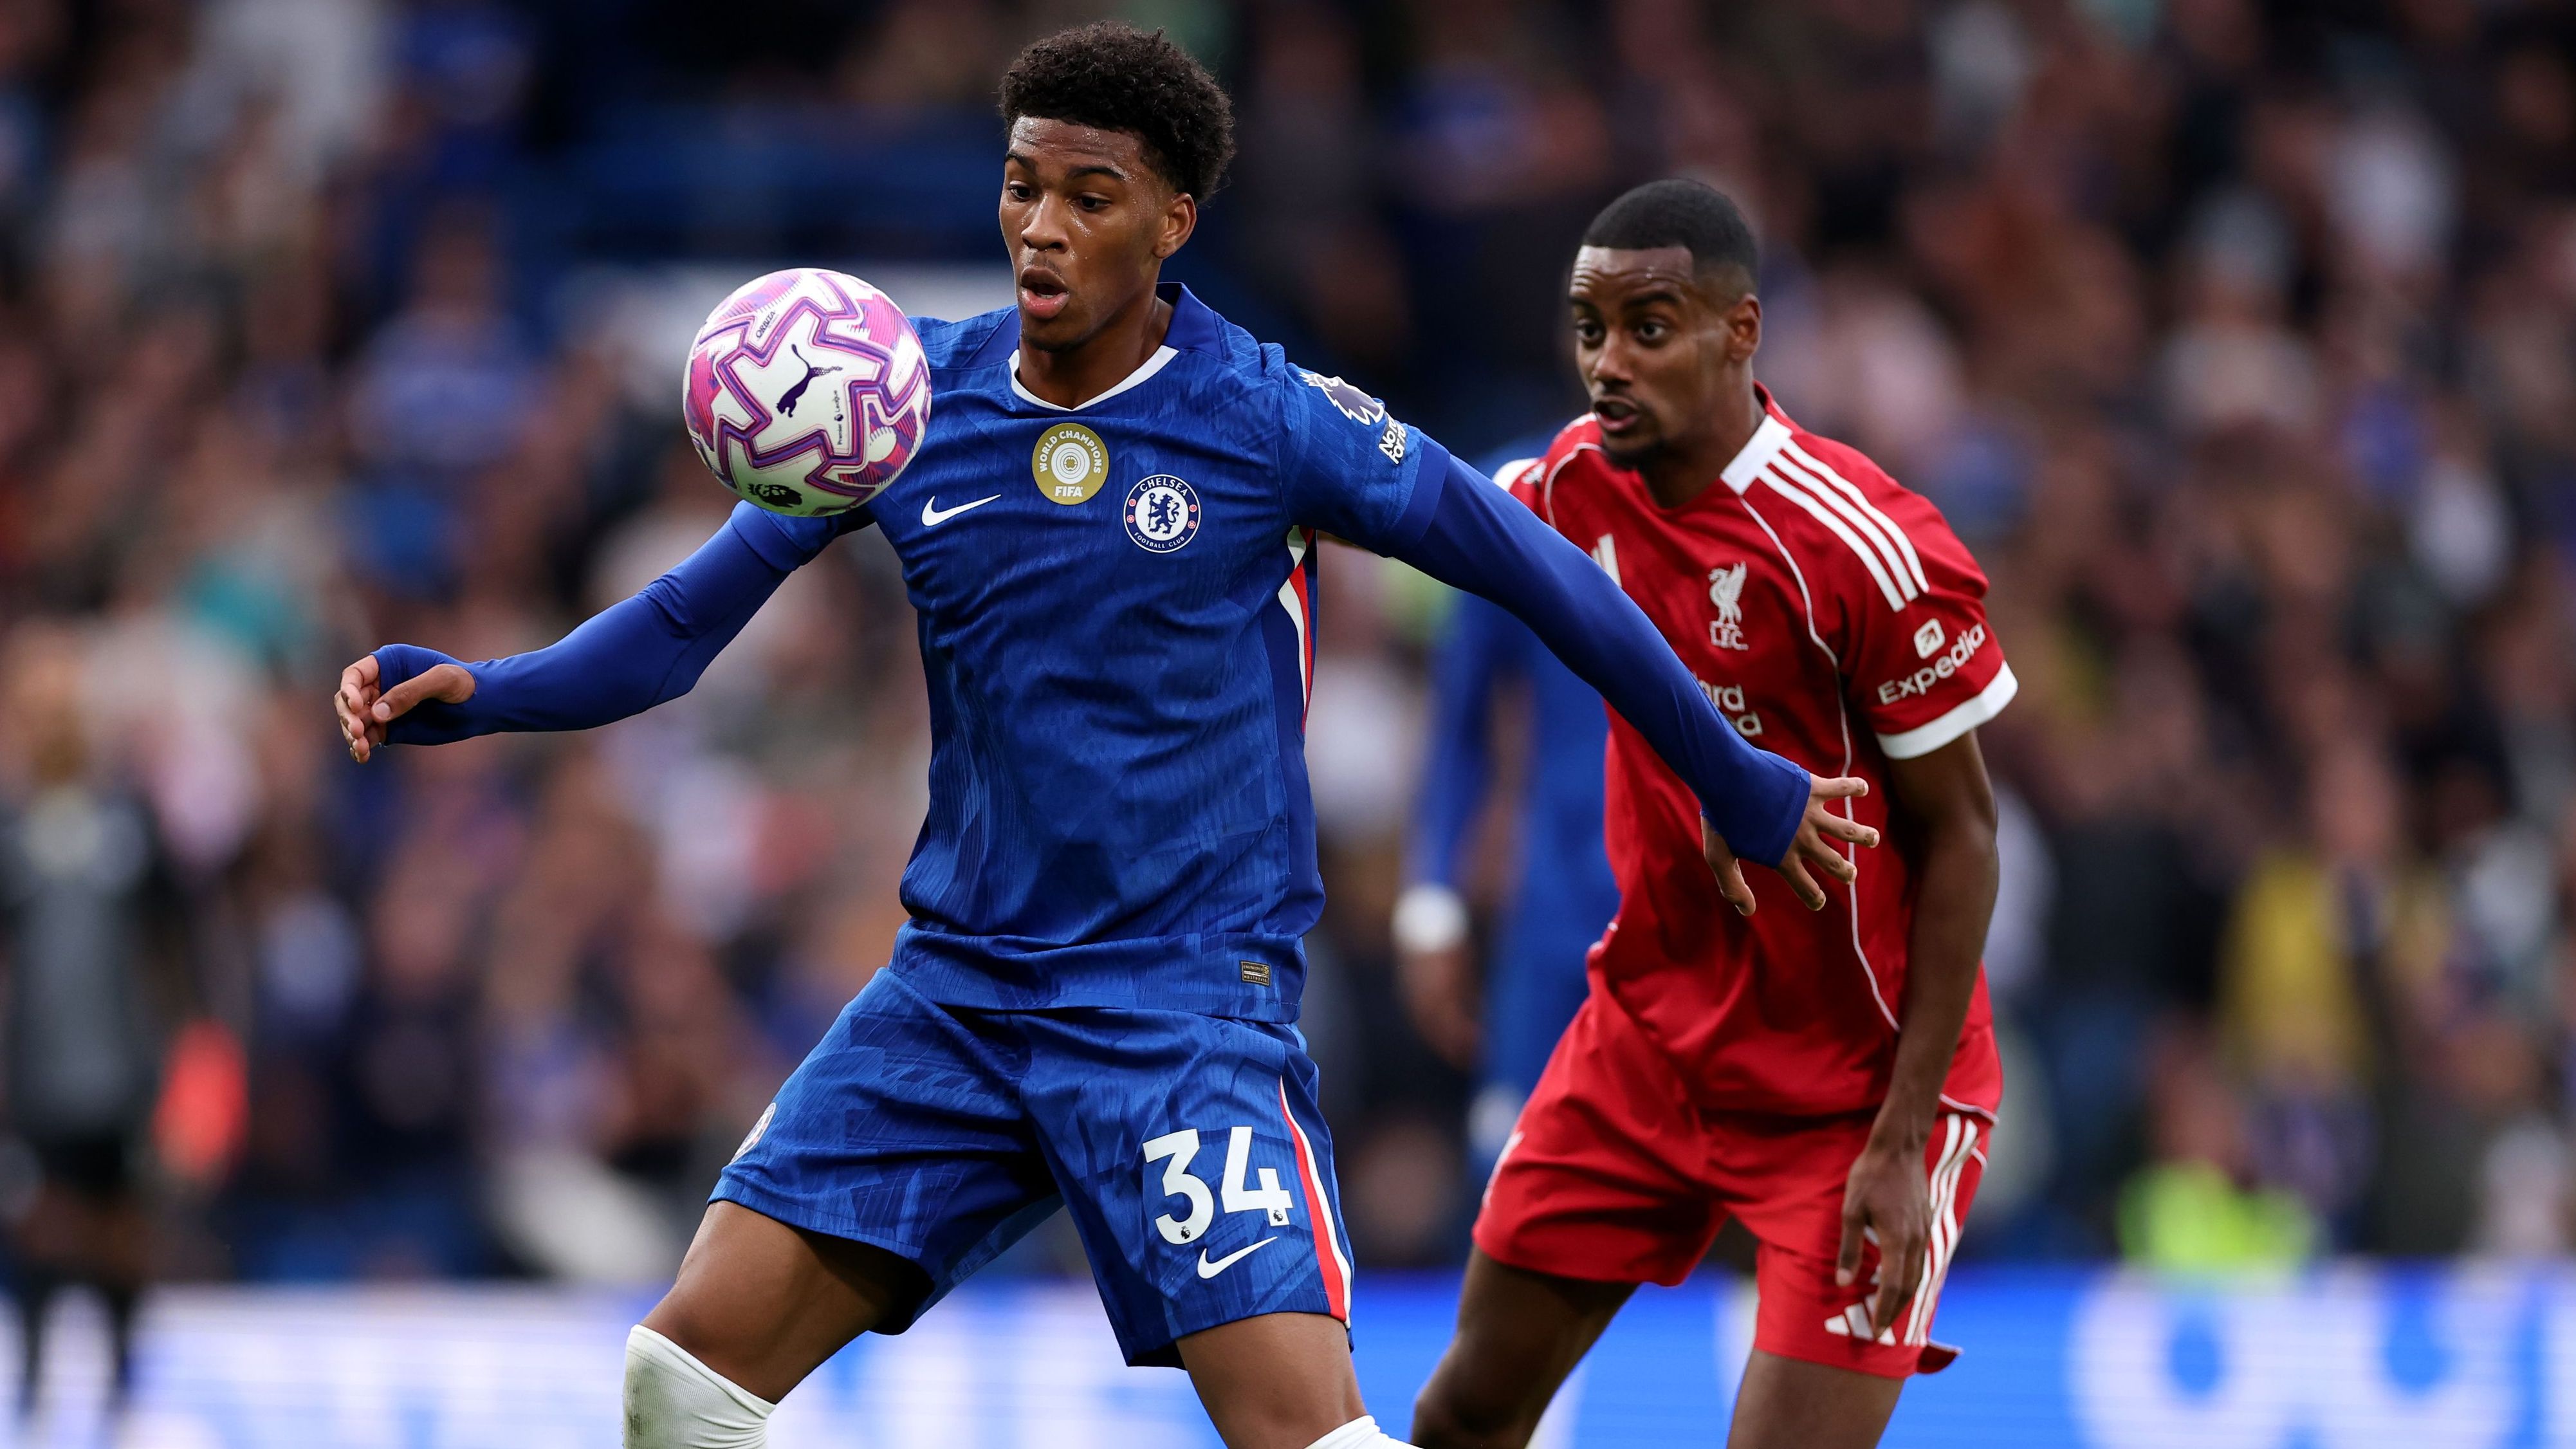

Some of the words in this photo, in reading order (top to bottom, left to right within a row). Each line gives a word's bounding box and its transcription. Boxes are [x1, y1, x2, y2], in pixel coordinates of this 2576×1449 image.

[756, 311, 775, 338] ORBITA
[1040, 436, 1058, 472] WORLD
[1058, 430, 1102, 474] CHAMPIONS
[1379, 430, 1396, 456] No
[1055, 486, 1083, 497] FIFA
[1139, 477, 1188, 497] CHELSEA
[1134, 531, 1166, 548] FOOTBALL
[1168, 536, 1185, 548] CLUB
[1877, 622, 1986, 705] Expedia
[1143, 1126, 1294, 1245] 34
